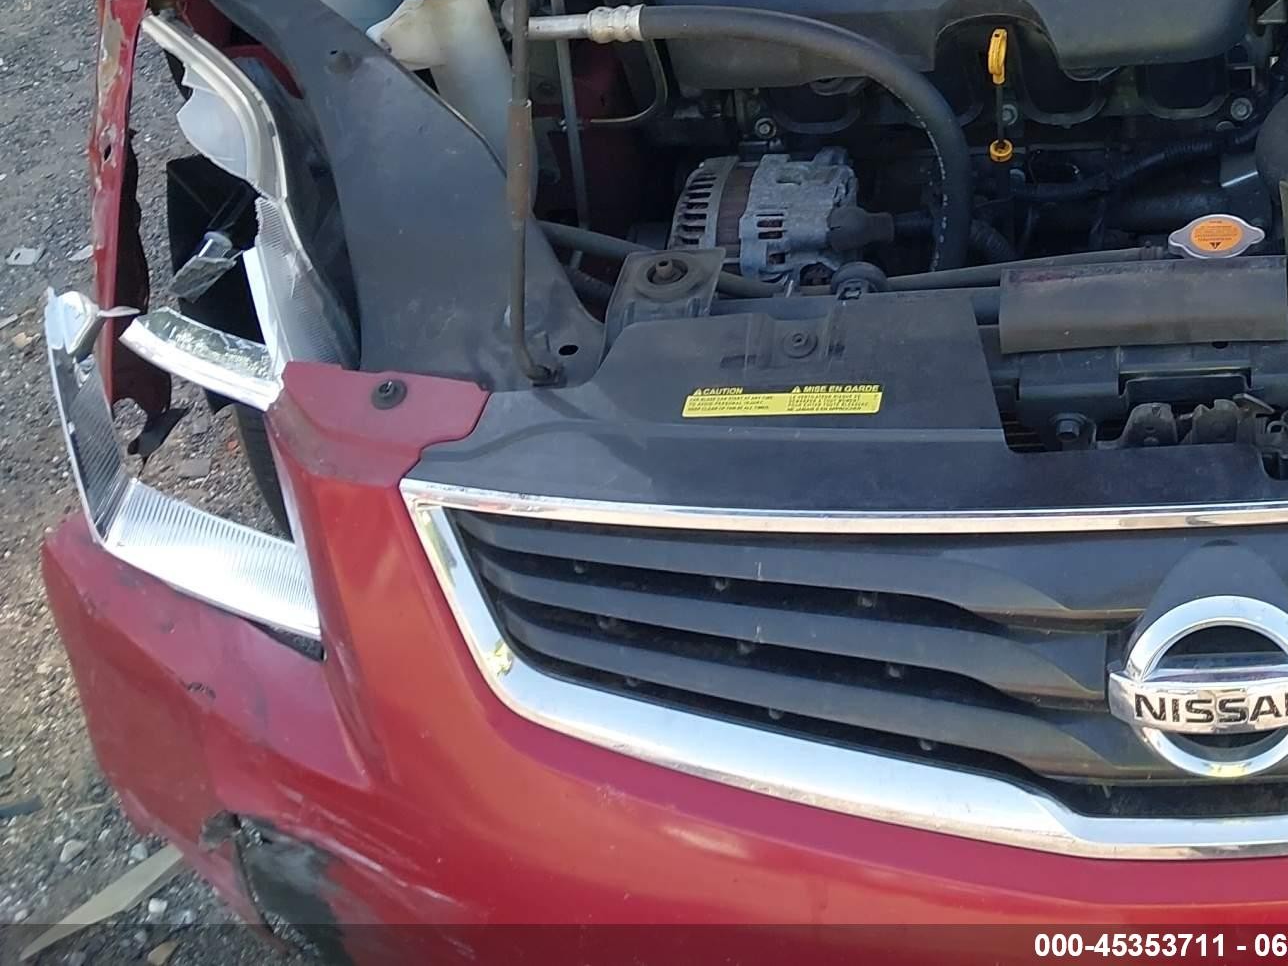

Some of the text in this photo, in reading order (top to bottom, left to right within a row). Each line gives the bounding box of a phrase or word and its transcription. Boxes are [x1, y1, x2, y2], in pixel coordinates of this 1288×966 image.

[703, 387, 744, 395] CAUTION
[803, 384, 880, 393] MISE EN GARDE
